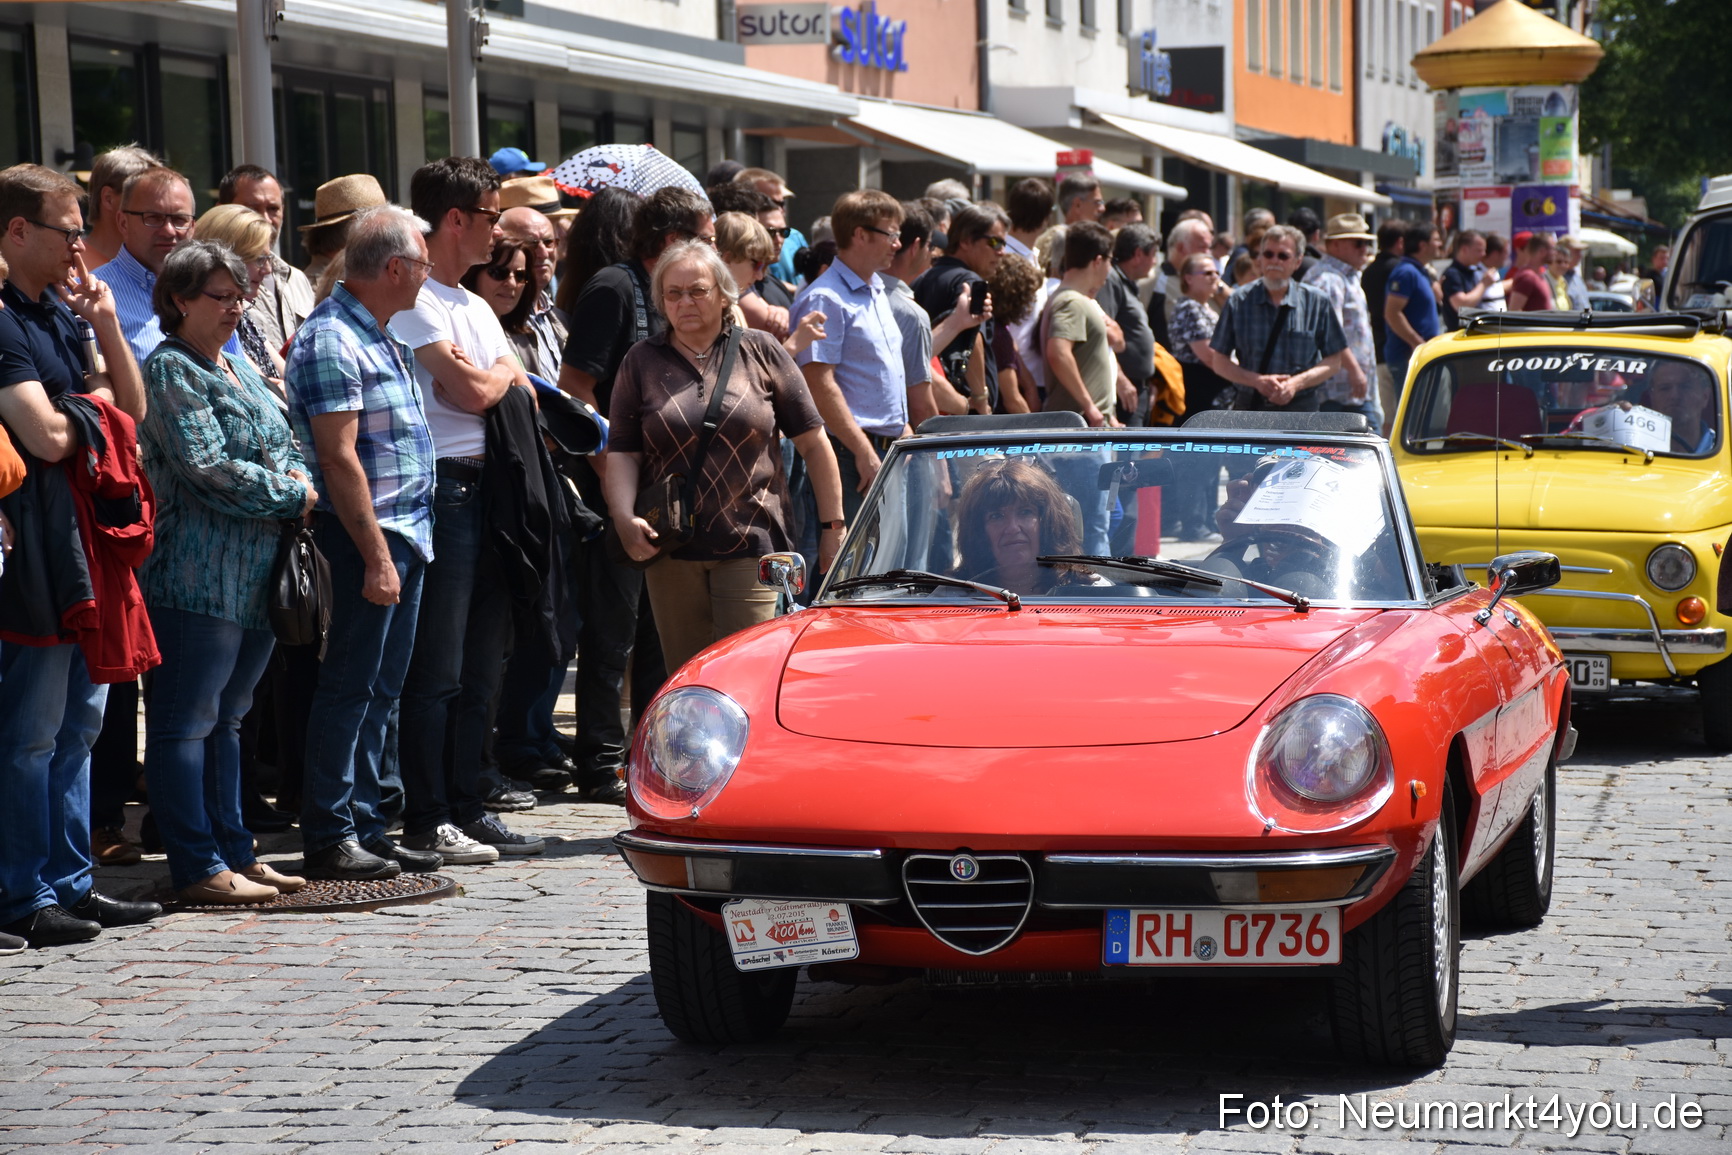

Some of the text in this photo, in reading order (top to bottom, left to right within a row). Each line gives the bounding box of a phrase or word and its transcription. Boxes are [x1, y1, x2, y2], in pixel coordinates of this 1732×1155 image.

[739, 9, 824, 37] sutor.
[1488, 357, 1648, 375] GOODYEAR
[1624, 414, 1656, 432] 466
[936, 441, 1311, 459] www.adam-riese-classic.de
[1592, 660, 1604, 668] 04
[1592, 678, 1605, 686] 09
[767, 911, 805, 921] 2.07.2015
[827, 925, 849, 933] BRUNNEN
[1136, 913, 1193, 957] RH
[1223, 913, 1330, 957] 0736
[822, 947, 851, 956] Köstner
[1112, 941, 1122, 954] D
